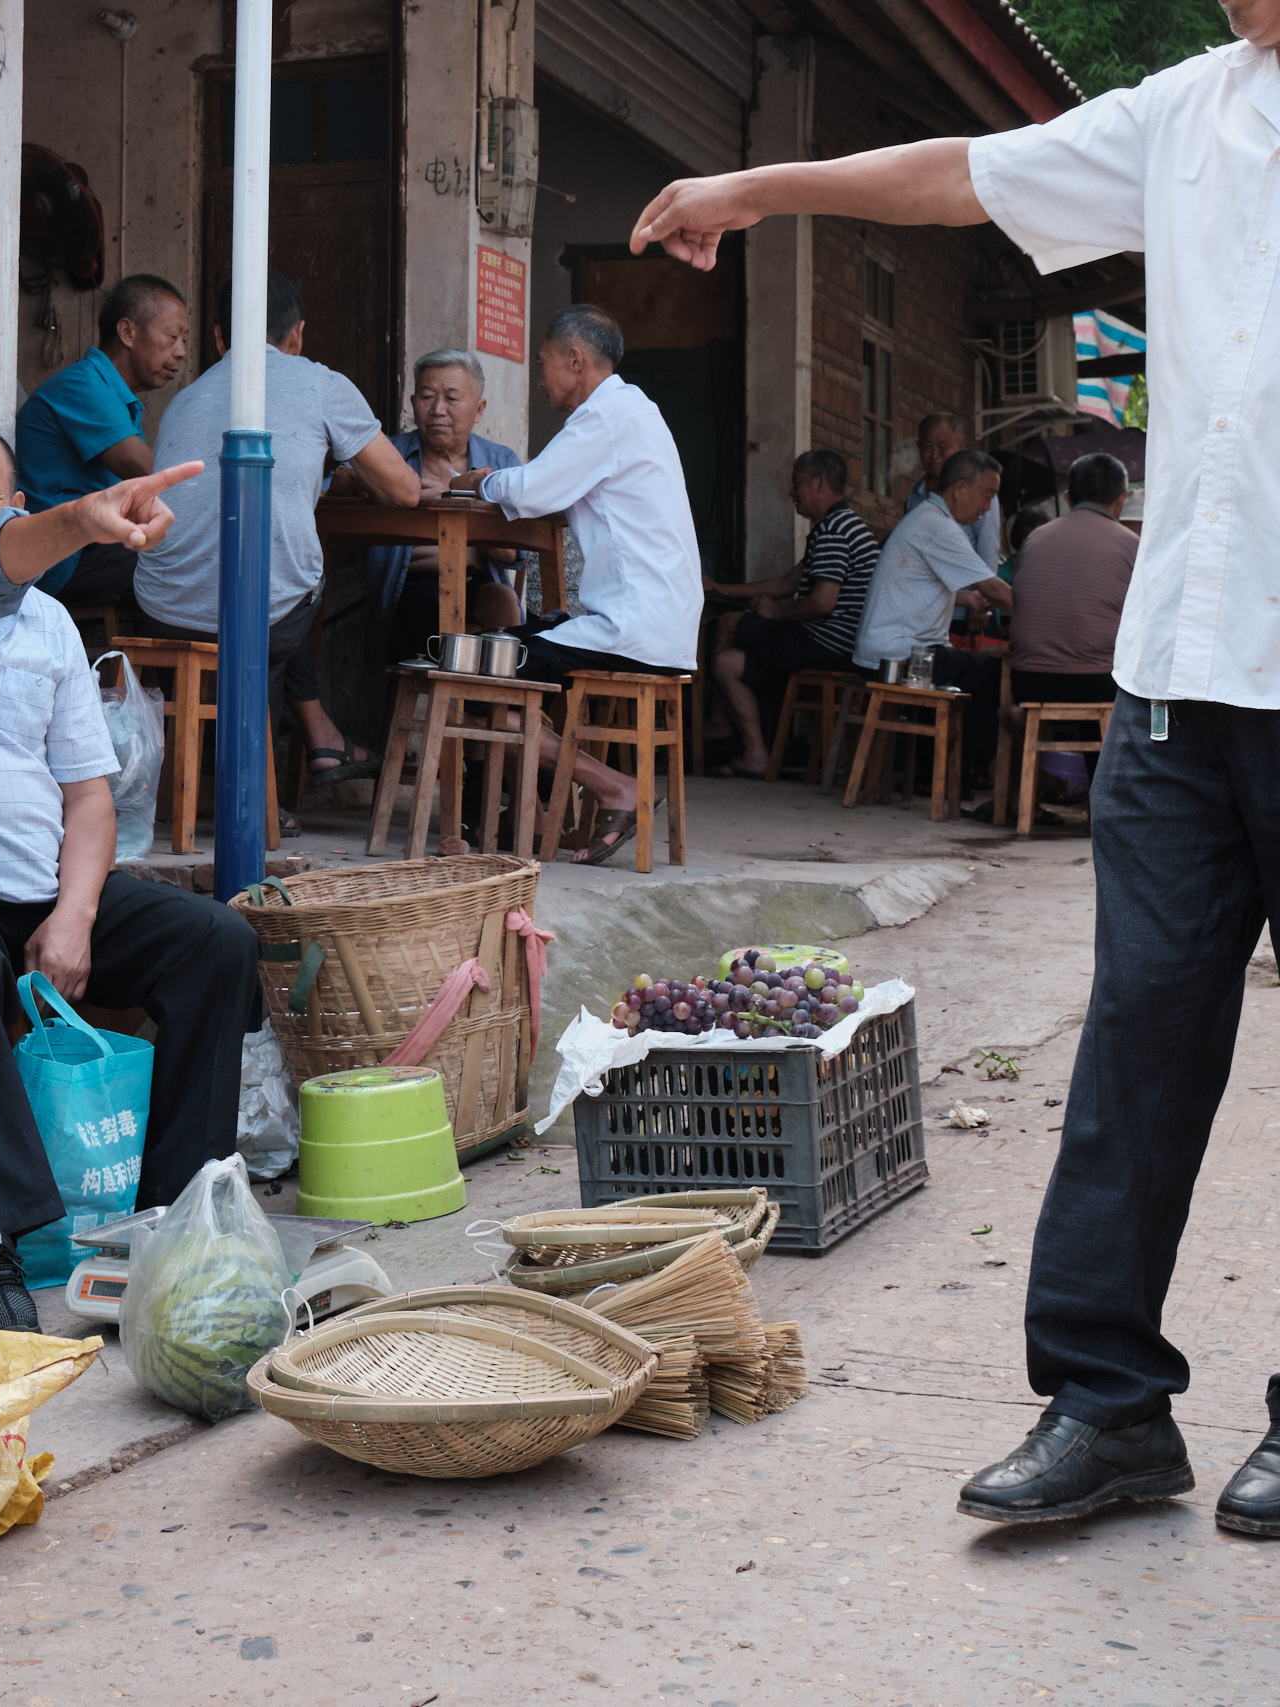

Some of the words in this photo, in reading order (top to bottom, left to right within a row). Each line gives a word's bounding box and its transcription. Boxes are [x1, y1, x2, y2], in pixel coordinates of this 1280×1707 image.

[76, 1110, 138, 1148] 依法禁毒
[81, 1155, 142, 1196] 构建和谐
